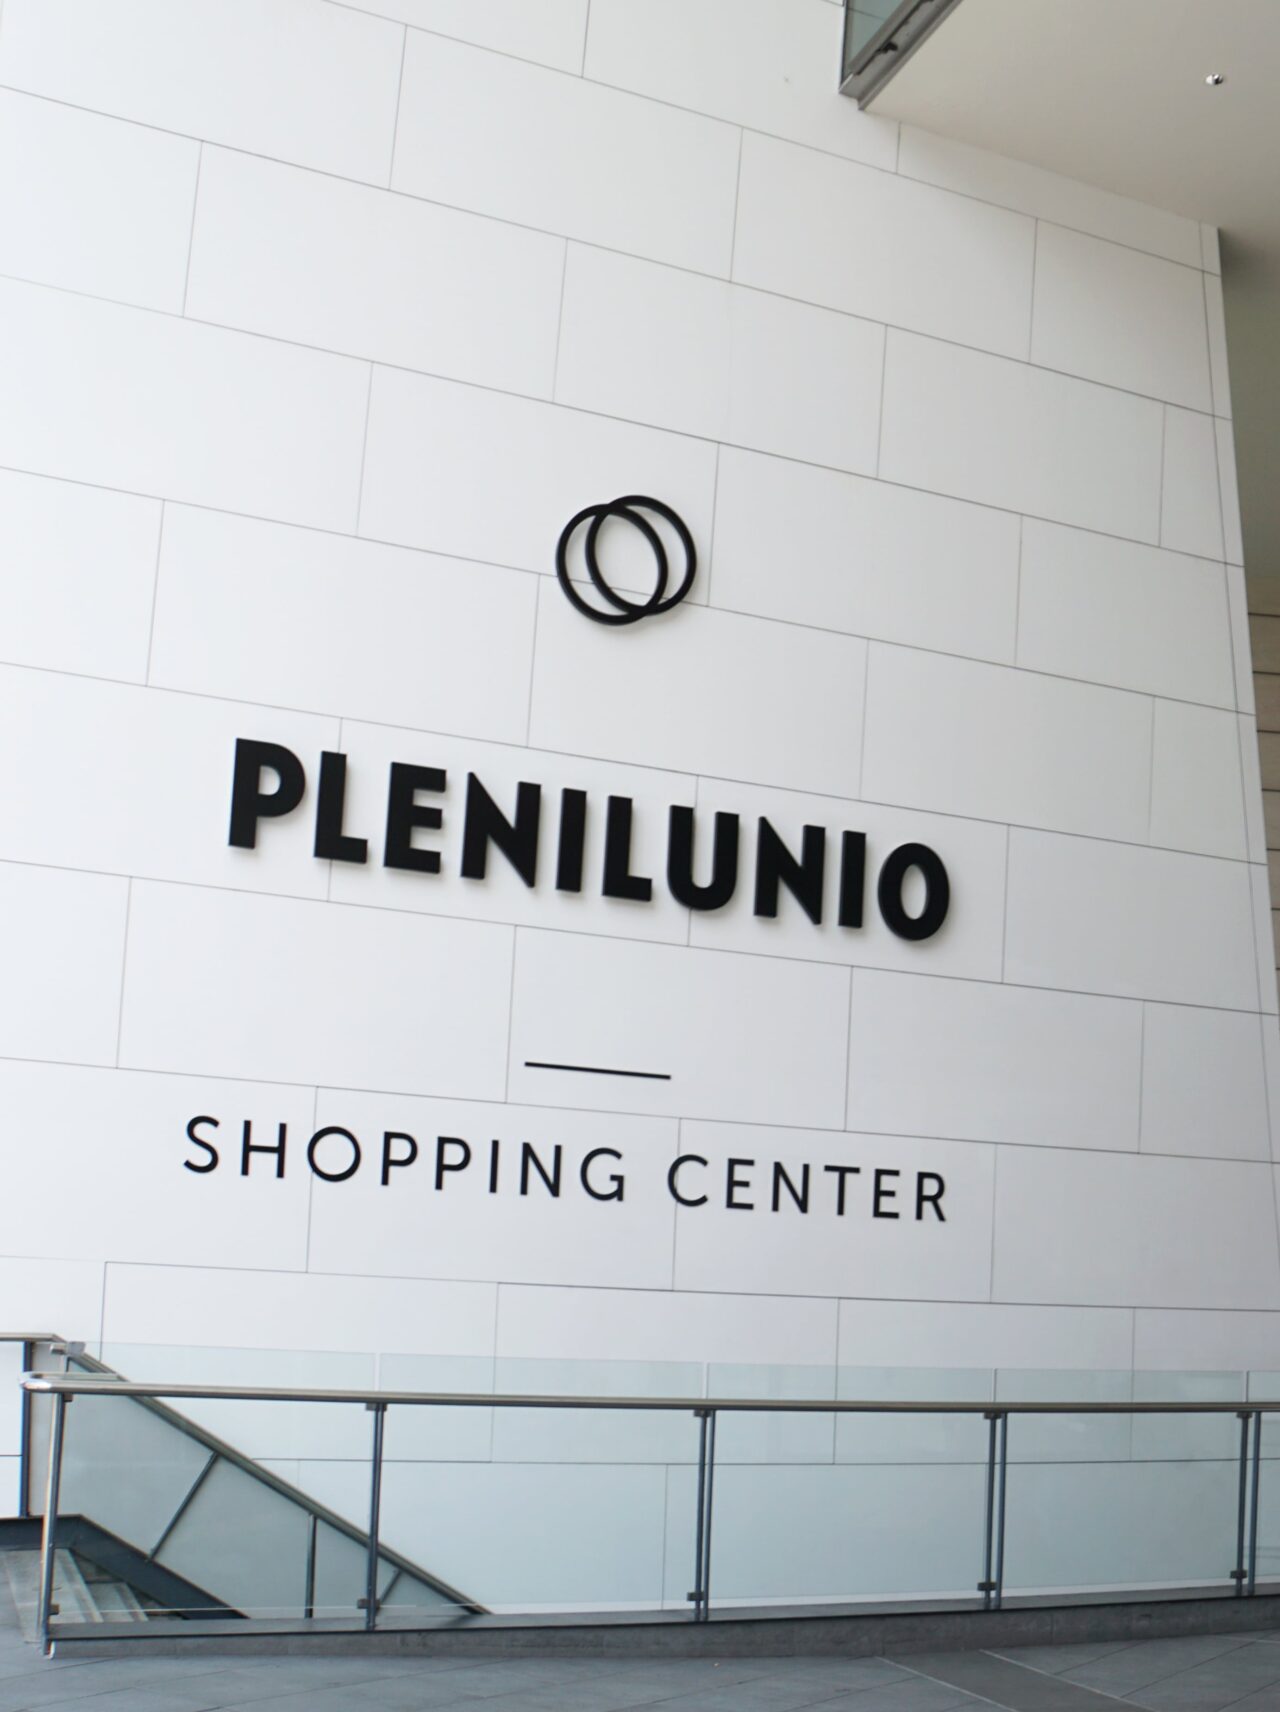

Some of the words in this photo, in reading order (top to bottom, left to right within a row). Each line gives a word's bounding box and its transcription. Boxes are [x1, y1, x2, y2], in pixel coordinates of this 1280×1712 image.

[227, 736, 951, 943] PLENILUNIO
[182, 1114, 627, 1204] SHOPPING
[666, 1153, 948, 1224] CENTER
